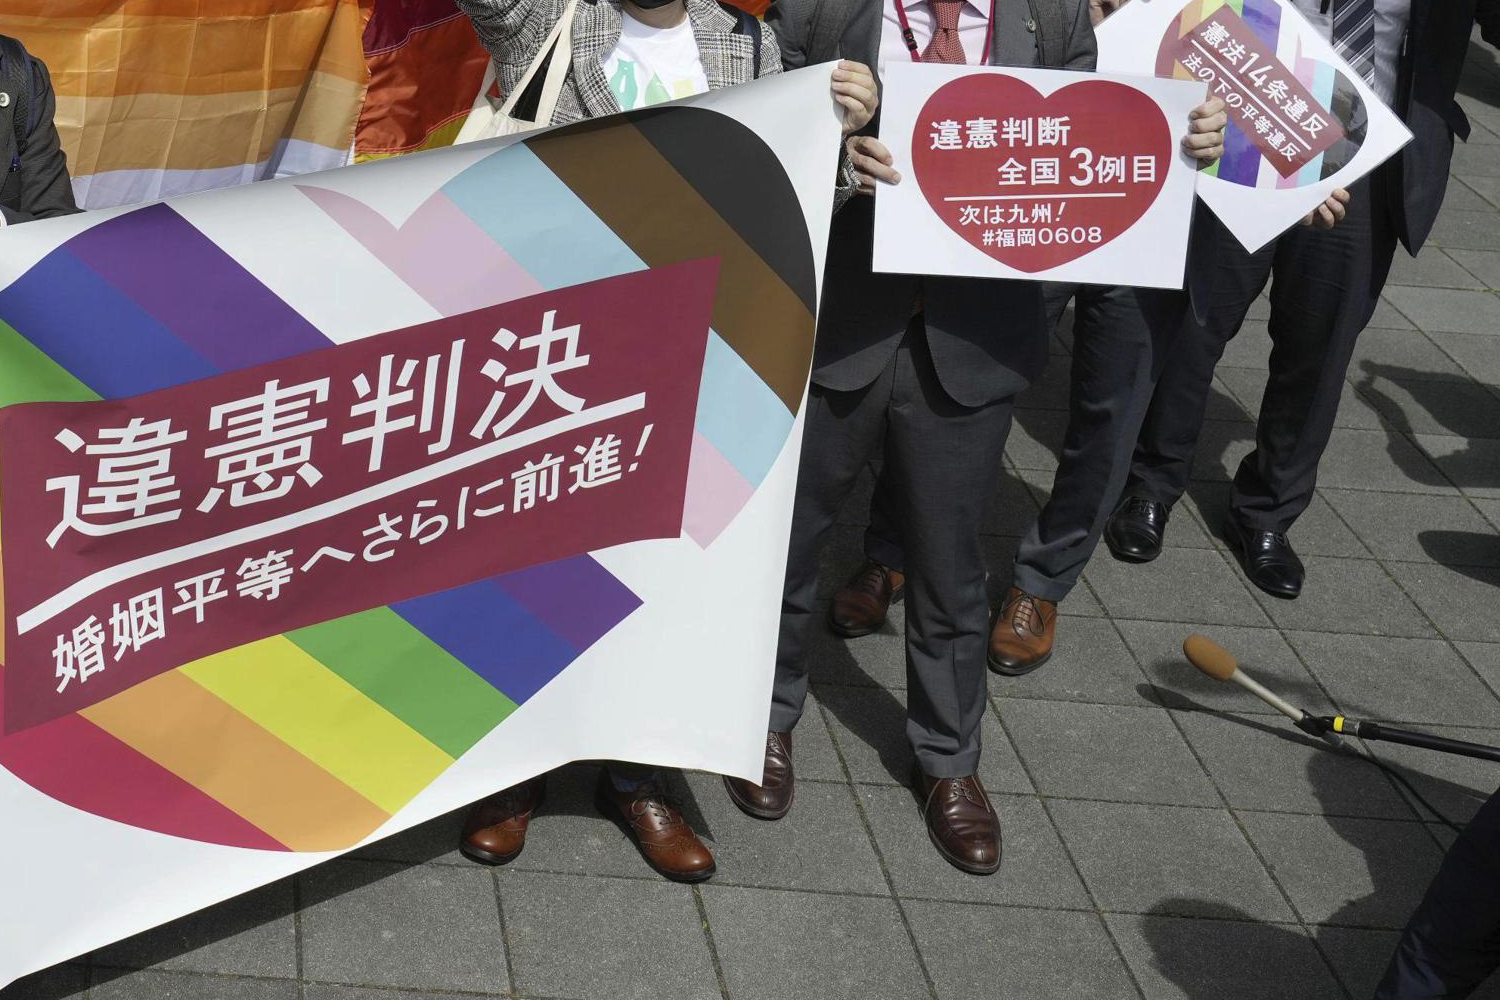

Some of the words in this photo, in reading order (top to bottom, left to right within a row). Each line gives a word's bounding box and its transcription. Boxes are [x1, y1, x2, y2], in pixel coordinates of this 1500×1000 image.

[1182, 52, 1301, 162] 法の下の平等違反
[1201, 21, 1329, 139] 憲法14条違反
[930, 115, 1071, 150] 違憲判断
[998, 147, 1156, 186] 全国3例目
[959, 202, 1066, 226] 次は九州!
[983, 226, 1102, 248] #福岡0608
[44, 309, 591, 549] 違憲判決
[52, 423, 655, 694] 婚姻平等へさらに前進!
